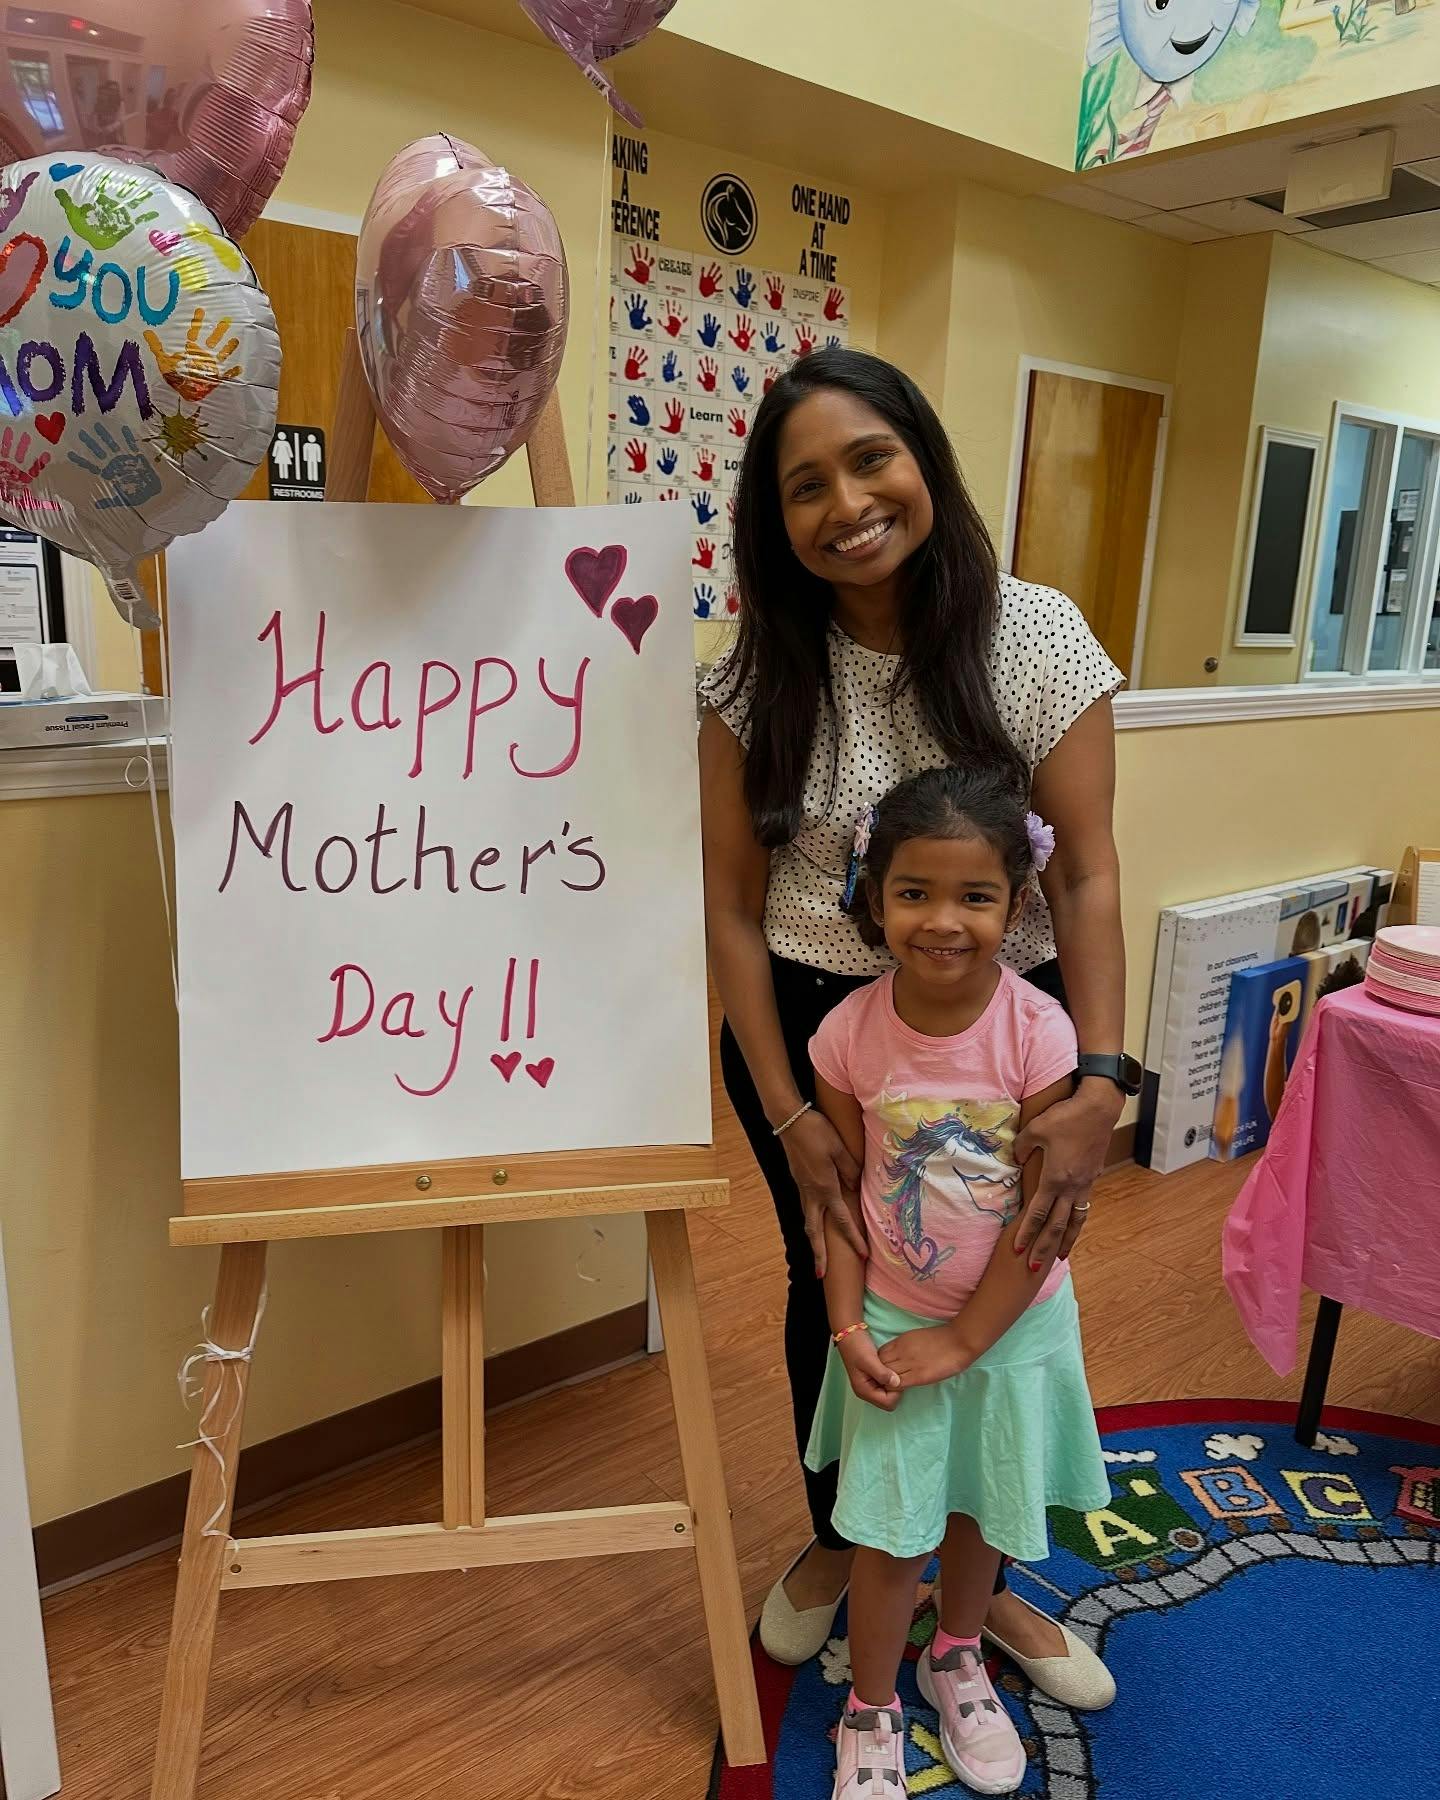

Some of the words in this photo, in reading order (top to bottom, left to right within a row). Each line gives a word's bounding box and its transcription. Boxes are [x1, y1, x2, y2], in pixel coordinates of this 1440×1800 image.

[612, 134, 648, 175] AKING
[620, 170, 629, 202] A
[792, 184, 817, 217] ONE
[818, 190, 850, 225] HAND
[811, 221, 826, 249] AT
[49, 235, 180, 327] YOU
[658, 257, 692, 276] CREATE
[799, 248, 807, 277] A
[810, 250, 837, 283] TIME
[0, 331, 154, 421] OM
[690, 406, 723, 423] Learn
[273, 488, 324, 499] RESTROOMS
[248, 610, 592, 780] Happy
[45, 724, 71, 732] Tissue
[72, 722, 95, 732] Facial
[95, 720, 129, 730] Premium
[218, 800, 606, 895] Mother's
[1084, 1508, 1159, 1558] A
[1199, 1472, 1269, 1514] B
[1300, 1477, 1365, 1515] C
